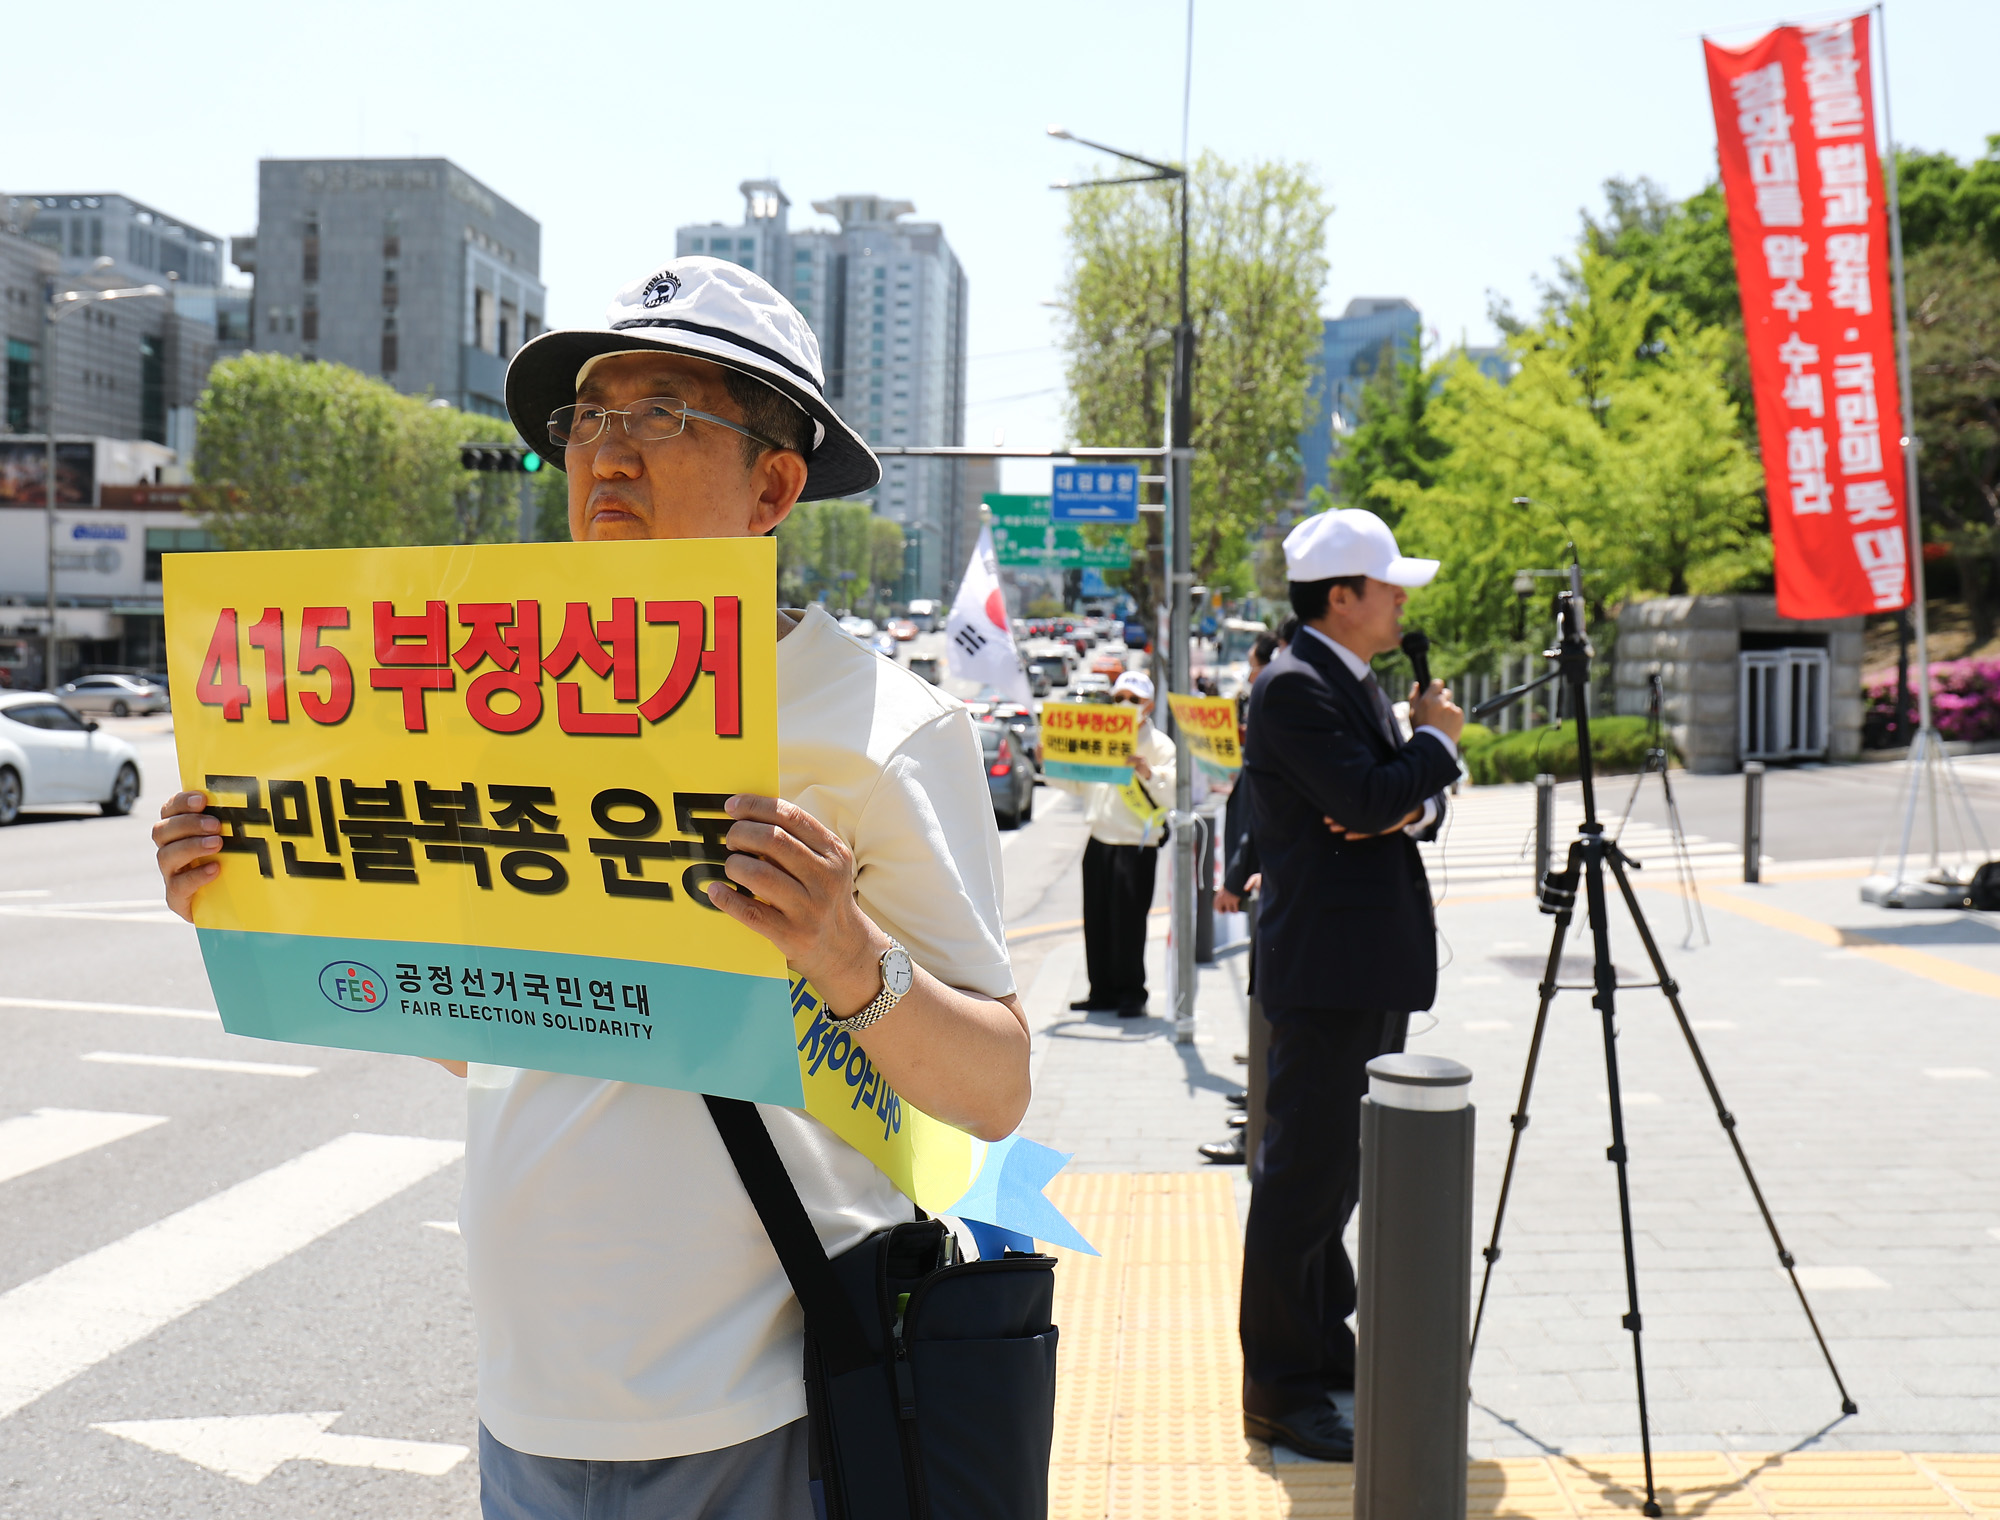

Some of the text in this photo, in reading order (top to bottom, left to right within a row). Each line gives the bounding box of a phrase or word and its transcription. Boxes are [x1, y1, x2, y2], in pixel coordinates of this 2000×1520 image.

[1816, 143, 1871, 227] 법과
[1762, 235, 1813, 323] 압수
[1825, 232, 1872, 316] 원칙
[1778, 331, 1825, 418] 수색
[1833, 353, 1884, 476] 국민의
[1786, 426, 1834, 515] 하라
[1844, 480, 1897, 525] 뜻
[195, 595, 742, 737] 415 부정선거
[1046, 711, 1134, 735] 415 부정선거
[200, 774, 569, 895] 국민불복종
[335, 978, 377, 1004] FES
[395, 963, 651, 1017] 공정선거국민연대
[400, 999, 653, 1040] FAIR ELECTION SOLIDARITY
